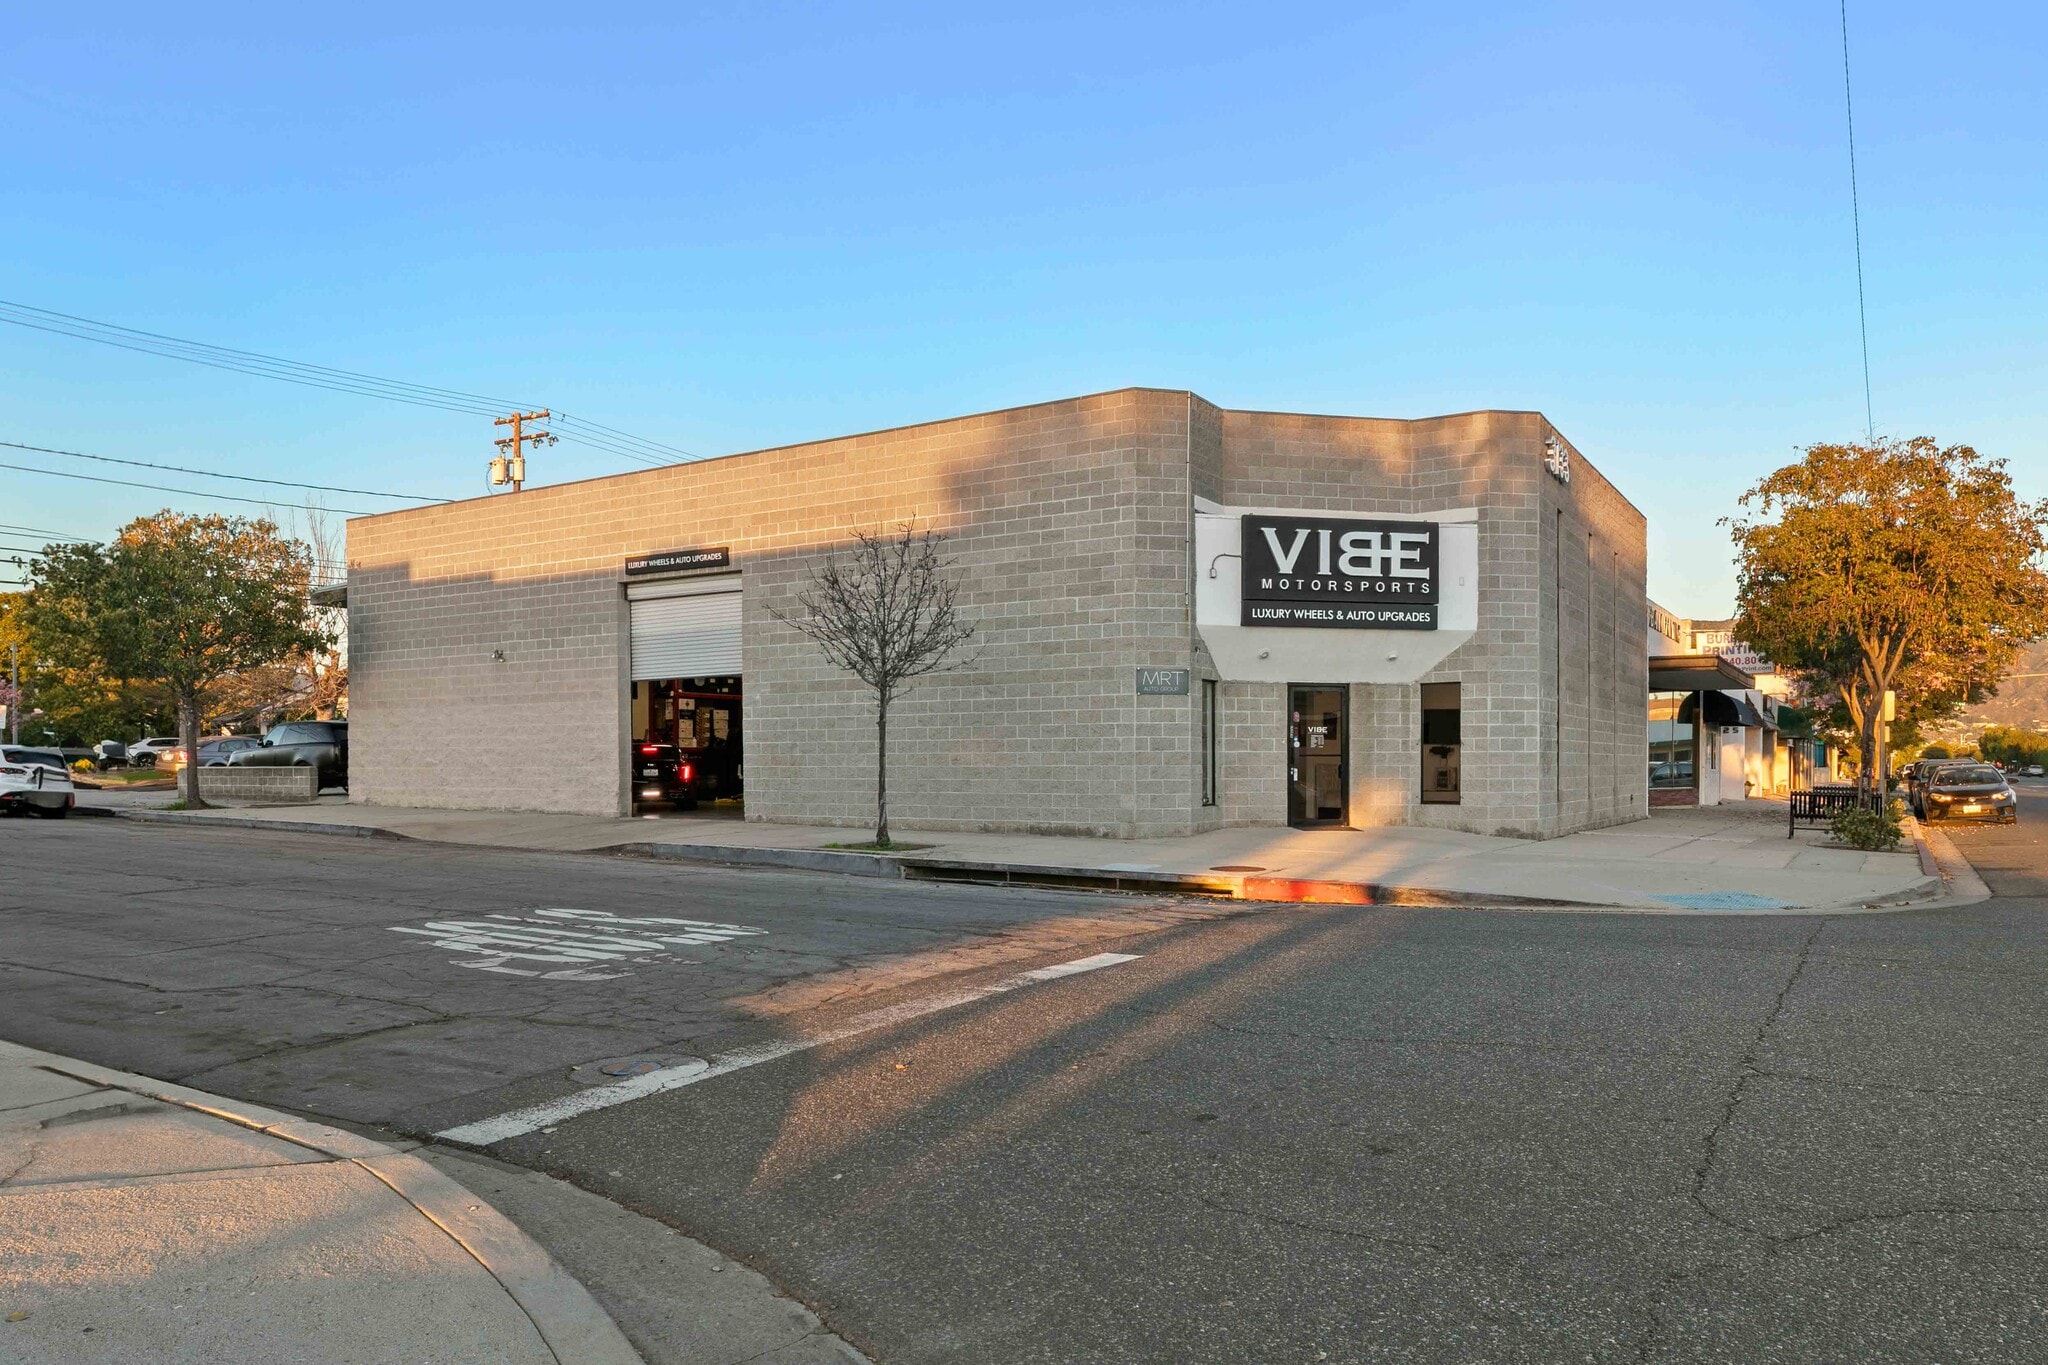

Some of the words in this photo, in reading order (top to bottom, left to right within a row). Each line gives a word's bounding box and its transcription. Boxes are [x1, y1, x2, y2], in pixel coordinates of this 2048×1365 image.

[627, 561, 648, 569] LUXURY
[648, 558, 670, 567] WHEELS
[670, 557, 675, 566] &
[675, 555, 691, 564] AUTO
[691, 552, 722, 563] UPGRADES
[1260, 526, 1430, 580] VIBE
[1261, 578, 1430, 594] MOTORSPORTS
[1252, 608, 1291, 619] LUXURY
[1293, 609, 1334, 620] WHEELS
[1336, 610, 1344, 620] &
[1346, 611, 1376, 621] AUTO
[1378, 612, 1431, 623] UPGRADES
[1142, 671, 1184, 685] MRT
